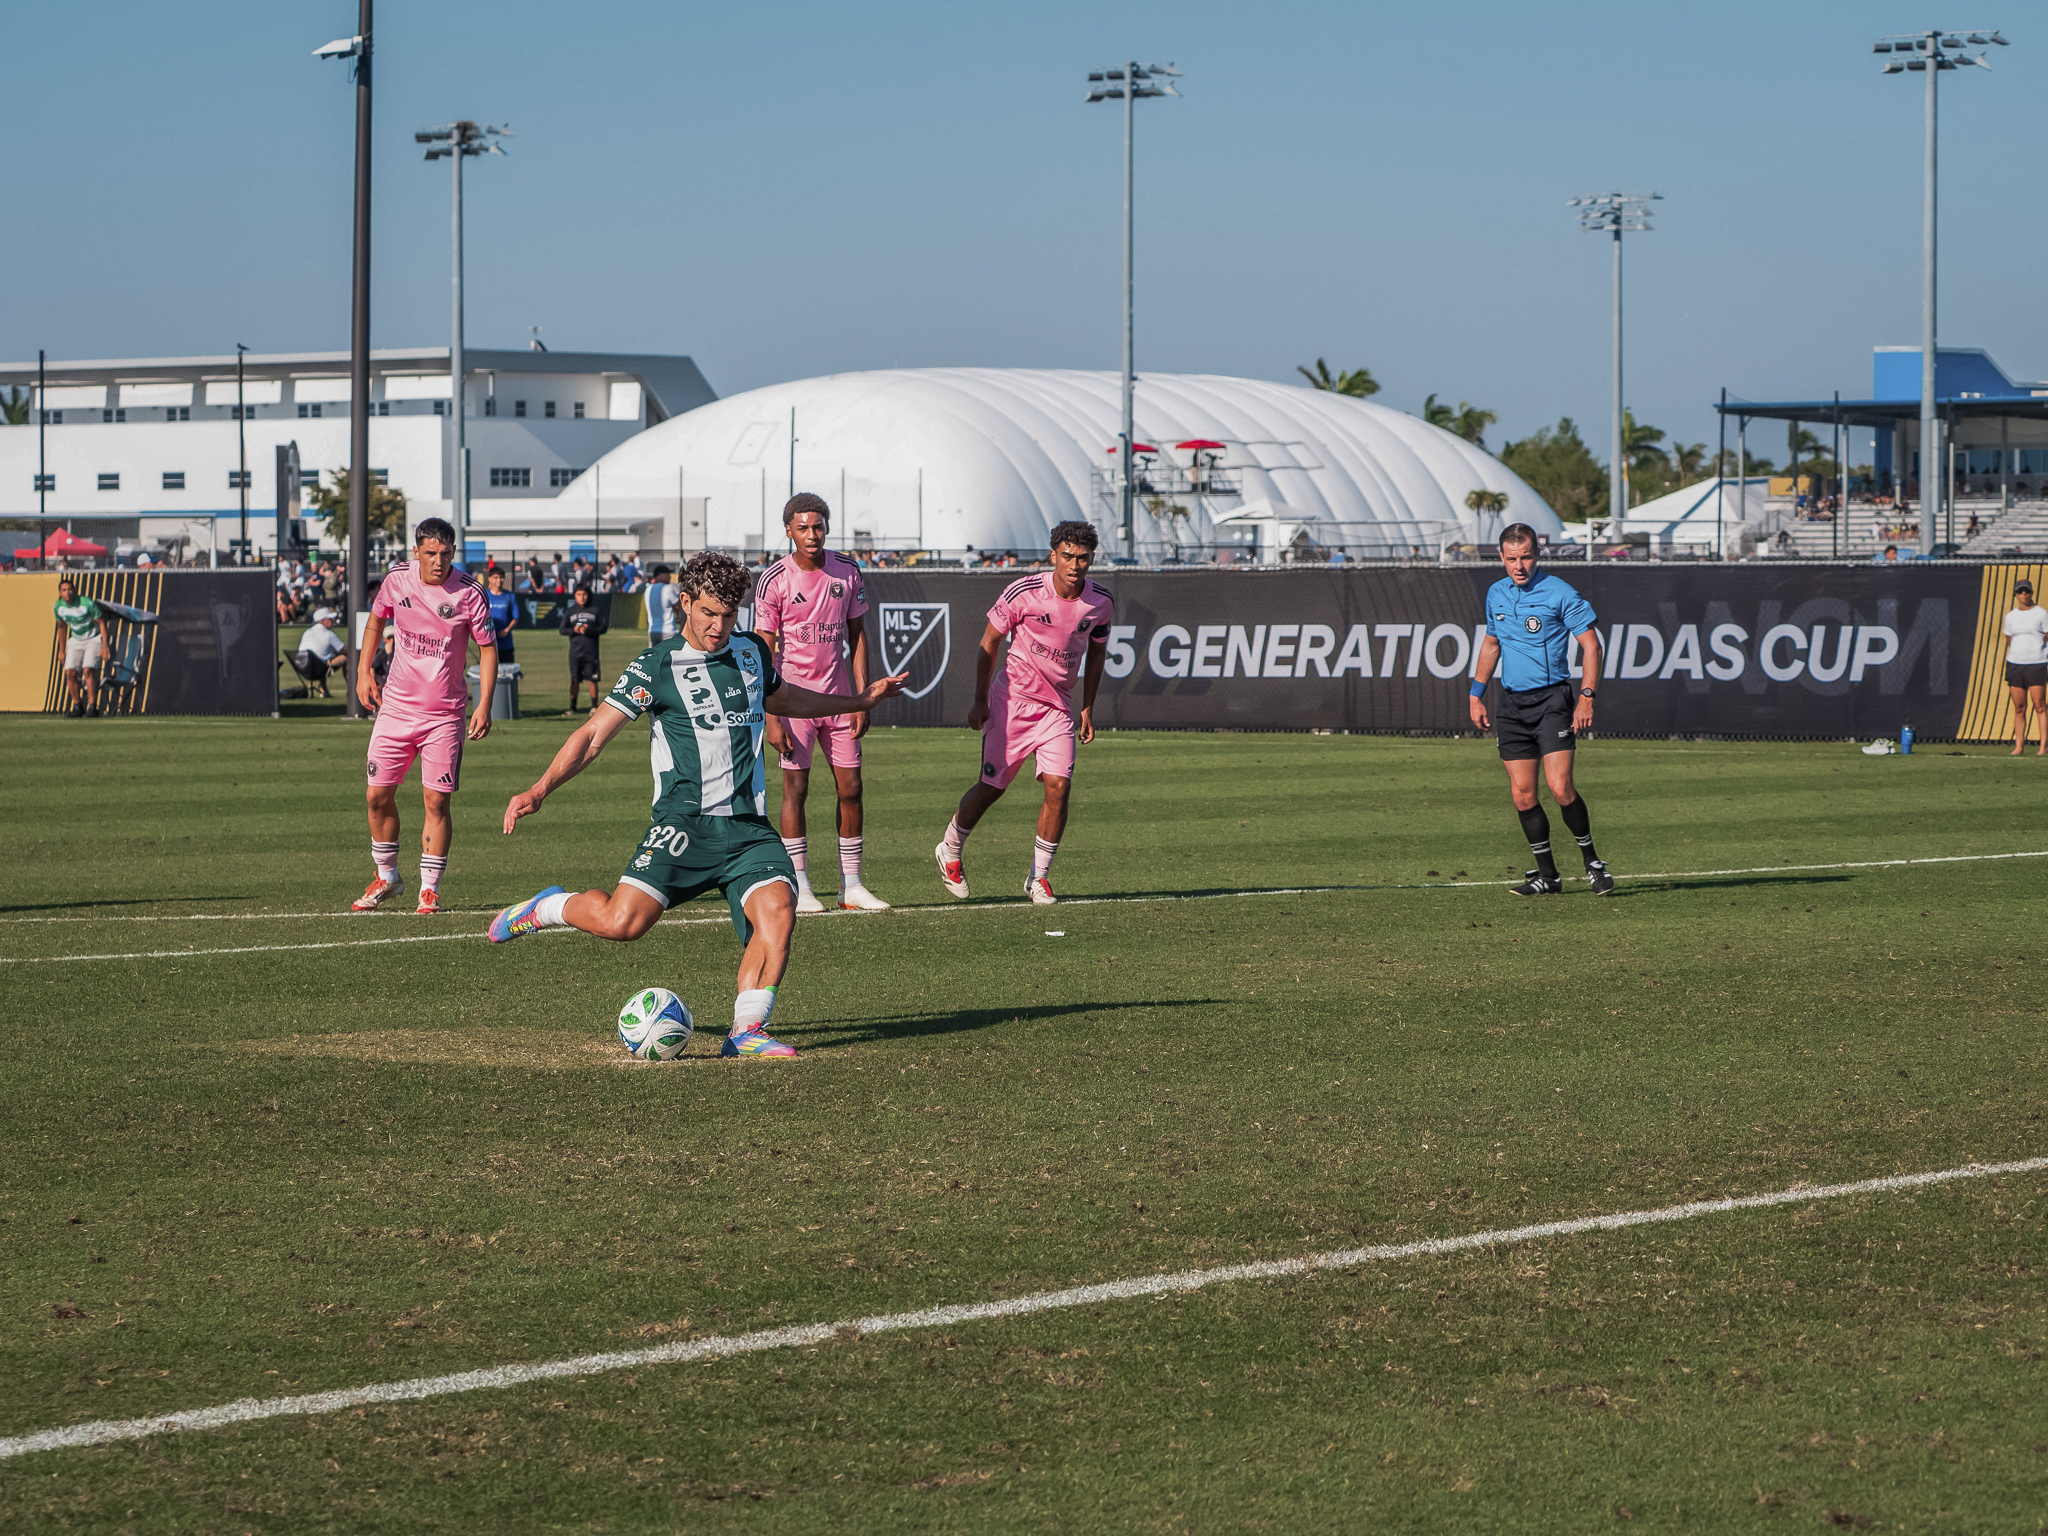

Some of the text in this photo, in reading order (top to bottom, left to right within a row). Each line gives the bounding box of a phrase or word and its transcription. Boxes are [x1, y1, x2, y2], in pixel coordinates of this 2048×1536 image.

[885, 610, 923, 631] MLS
[1104, 625, 1136, 678] 5
[1566, 623, 1749, 681] DIDAS
[1759, 623, 1899, 682] CUP
[642, 825, 690, 857] 320
